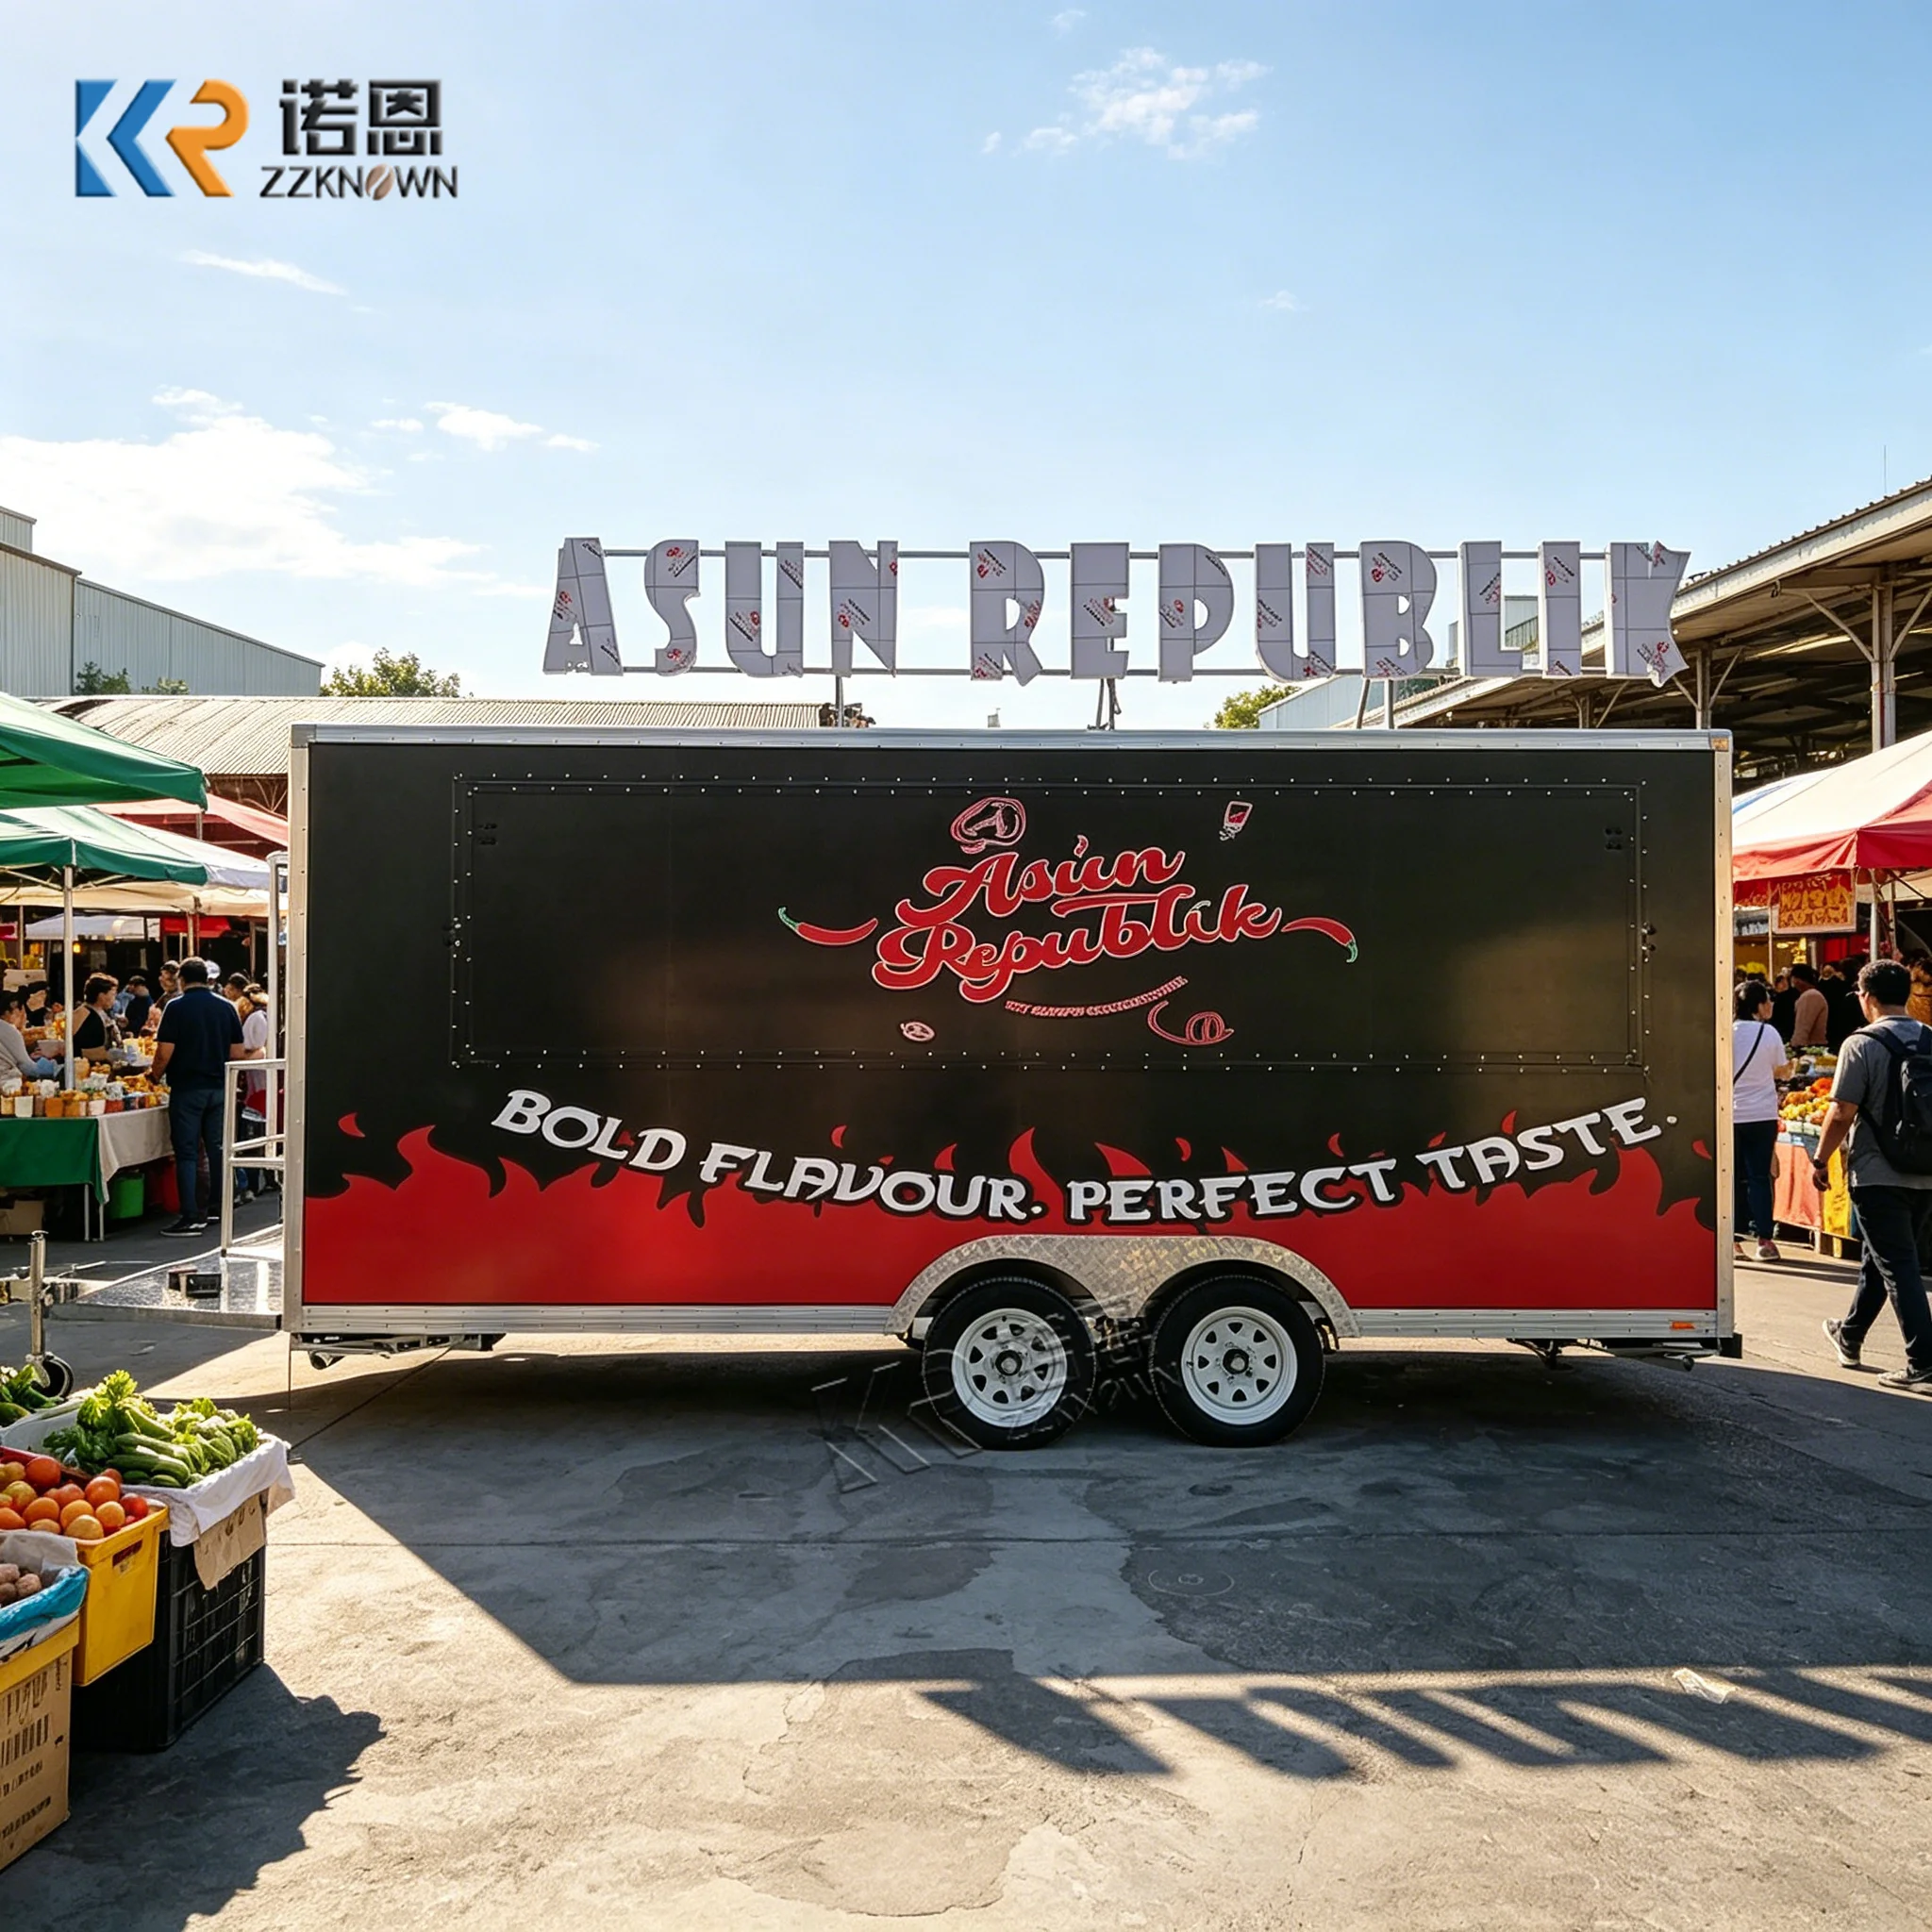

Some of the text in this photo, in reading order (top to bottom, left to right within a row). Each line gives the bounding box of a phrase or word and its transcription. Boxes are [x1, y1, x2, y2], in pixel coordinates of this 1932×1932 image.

[542, 537, 1692, 688] ASUN REPUBLIK
[872, 884, 1283, 1004] Republik
[491, 1088, 1679, 1224] BOLD FLAVOUR. PERFECT TASTE.
